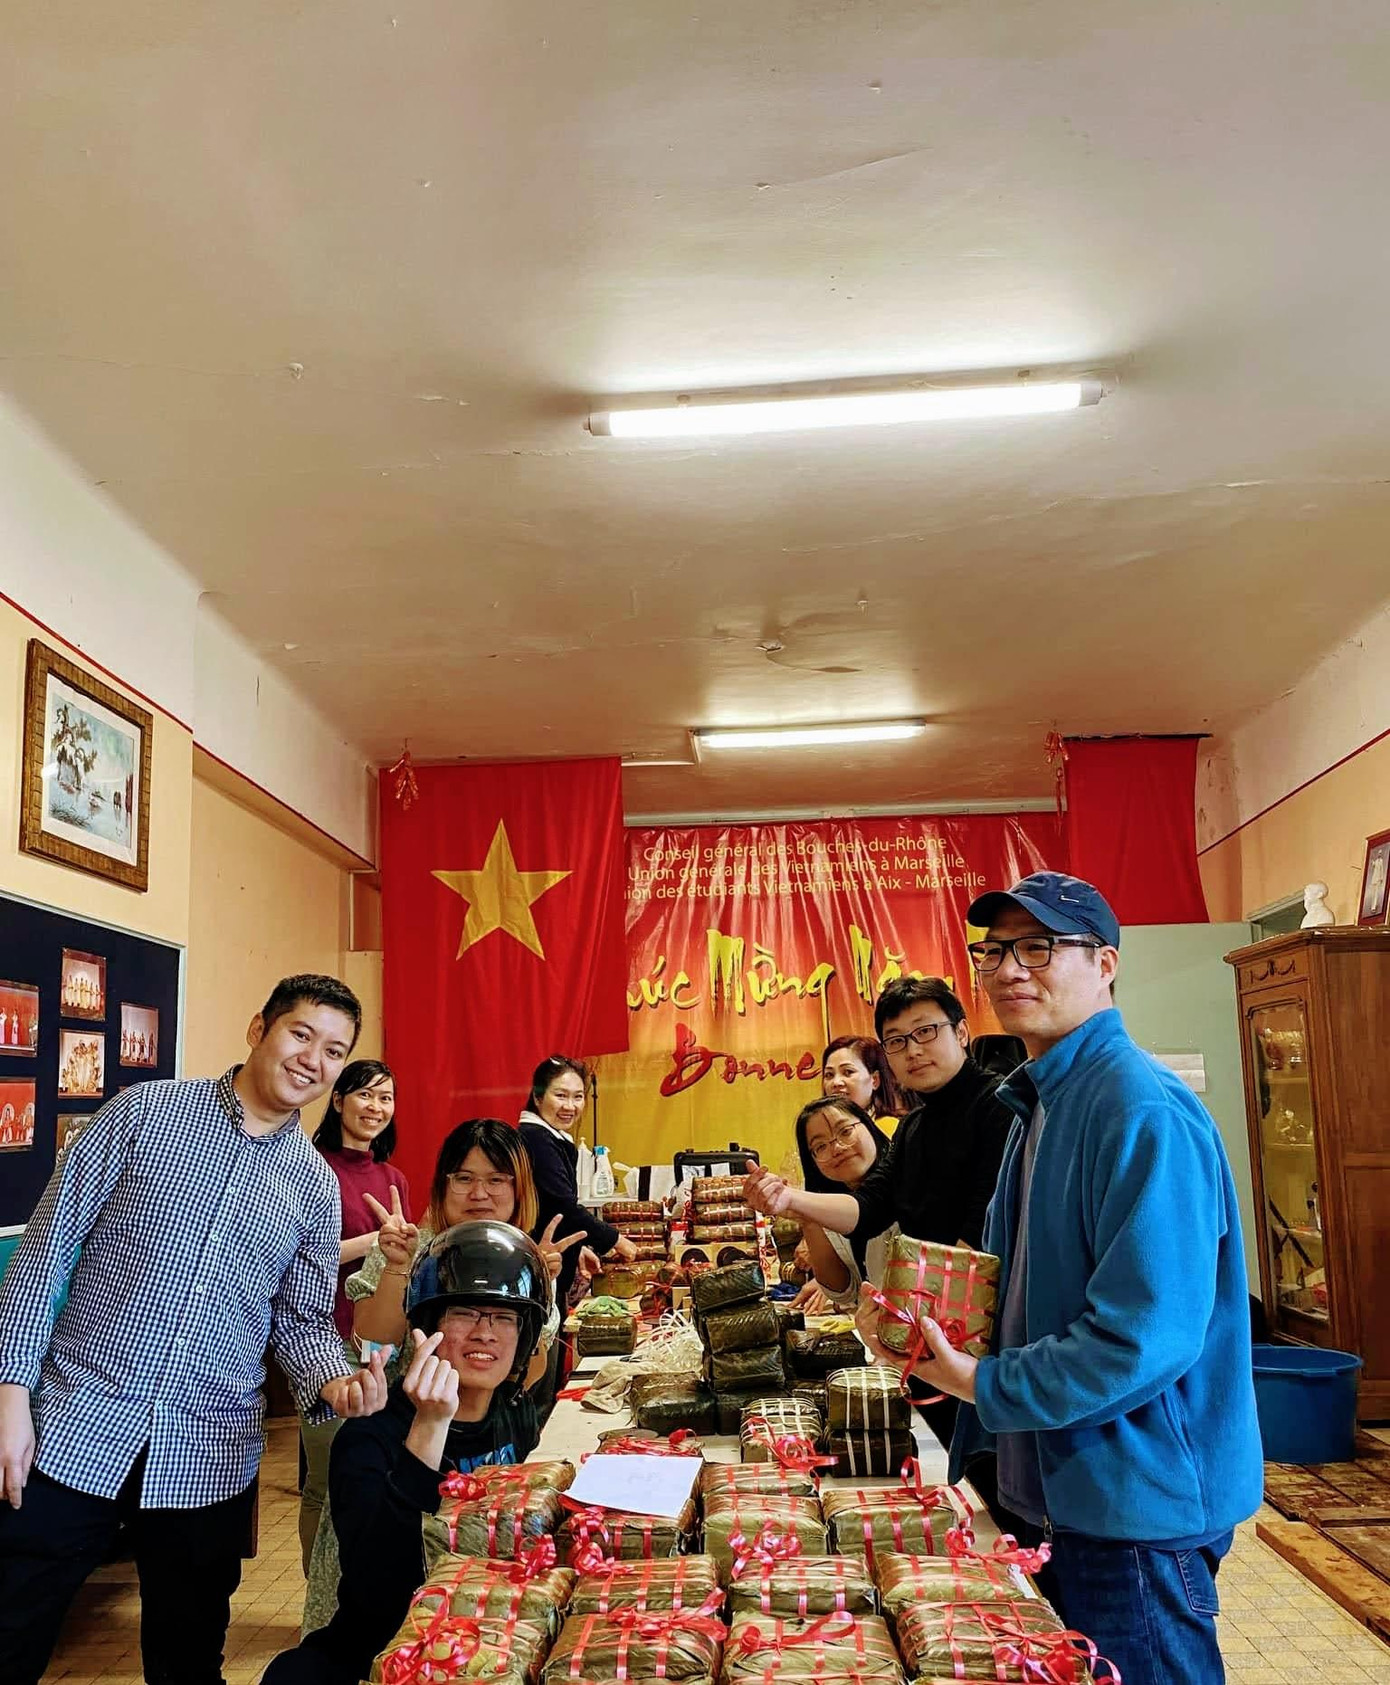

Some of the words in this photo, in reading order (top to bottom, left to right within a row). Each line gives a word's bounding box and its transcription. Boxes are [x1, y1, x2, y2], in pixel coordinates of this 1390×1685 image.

[643, 845, 699, 862] Conseil
[703, 842, 762, 863] général
[766, 841, 793, 856] des
[796, 836, 947, 855] Bouches-du-Rhône
[628, 866, 675, 881] Union
[751, 860, 778, 876] des
[781, 859, 877, 875] Vietnamiens
[880, 857, 890, 871] à
[894, 853, 965, 871] Marseille
[624, 885, 652, 900] ion
[656, 884, 683, 899] des
[763, 879, 859, 895] Vietnamiens
[877, 875, 902, 890] Aix
[915, 872, 986, 889] Marseille
[848, 924, 954, 1005] Nă
[660, 1022, 823, 1098] Bonne
